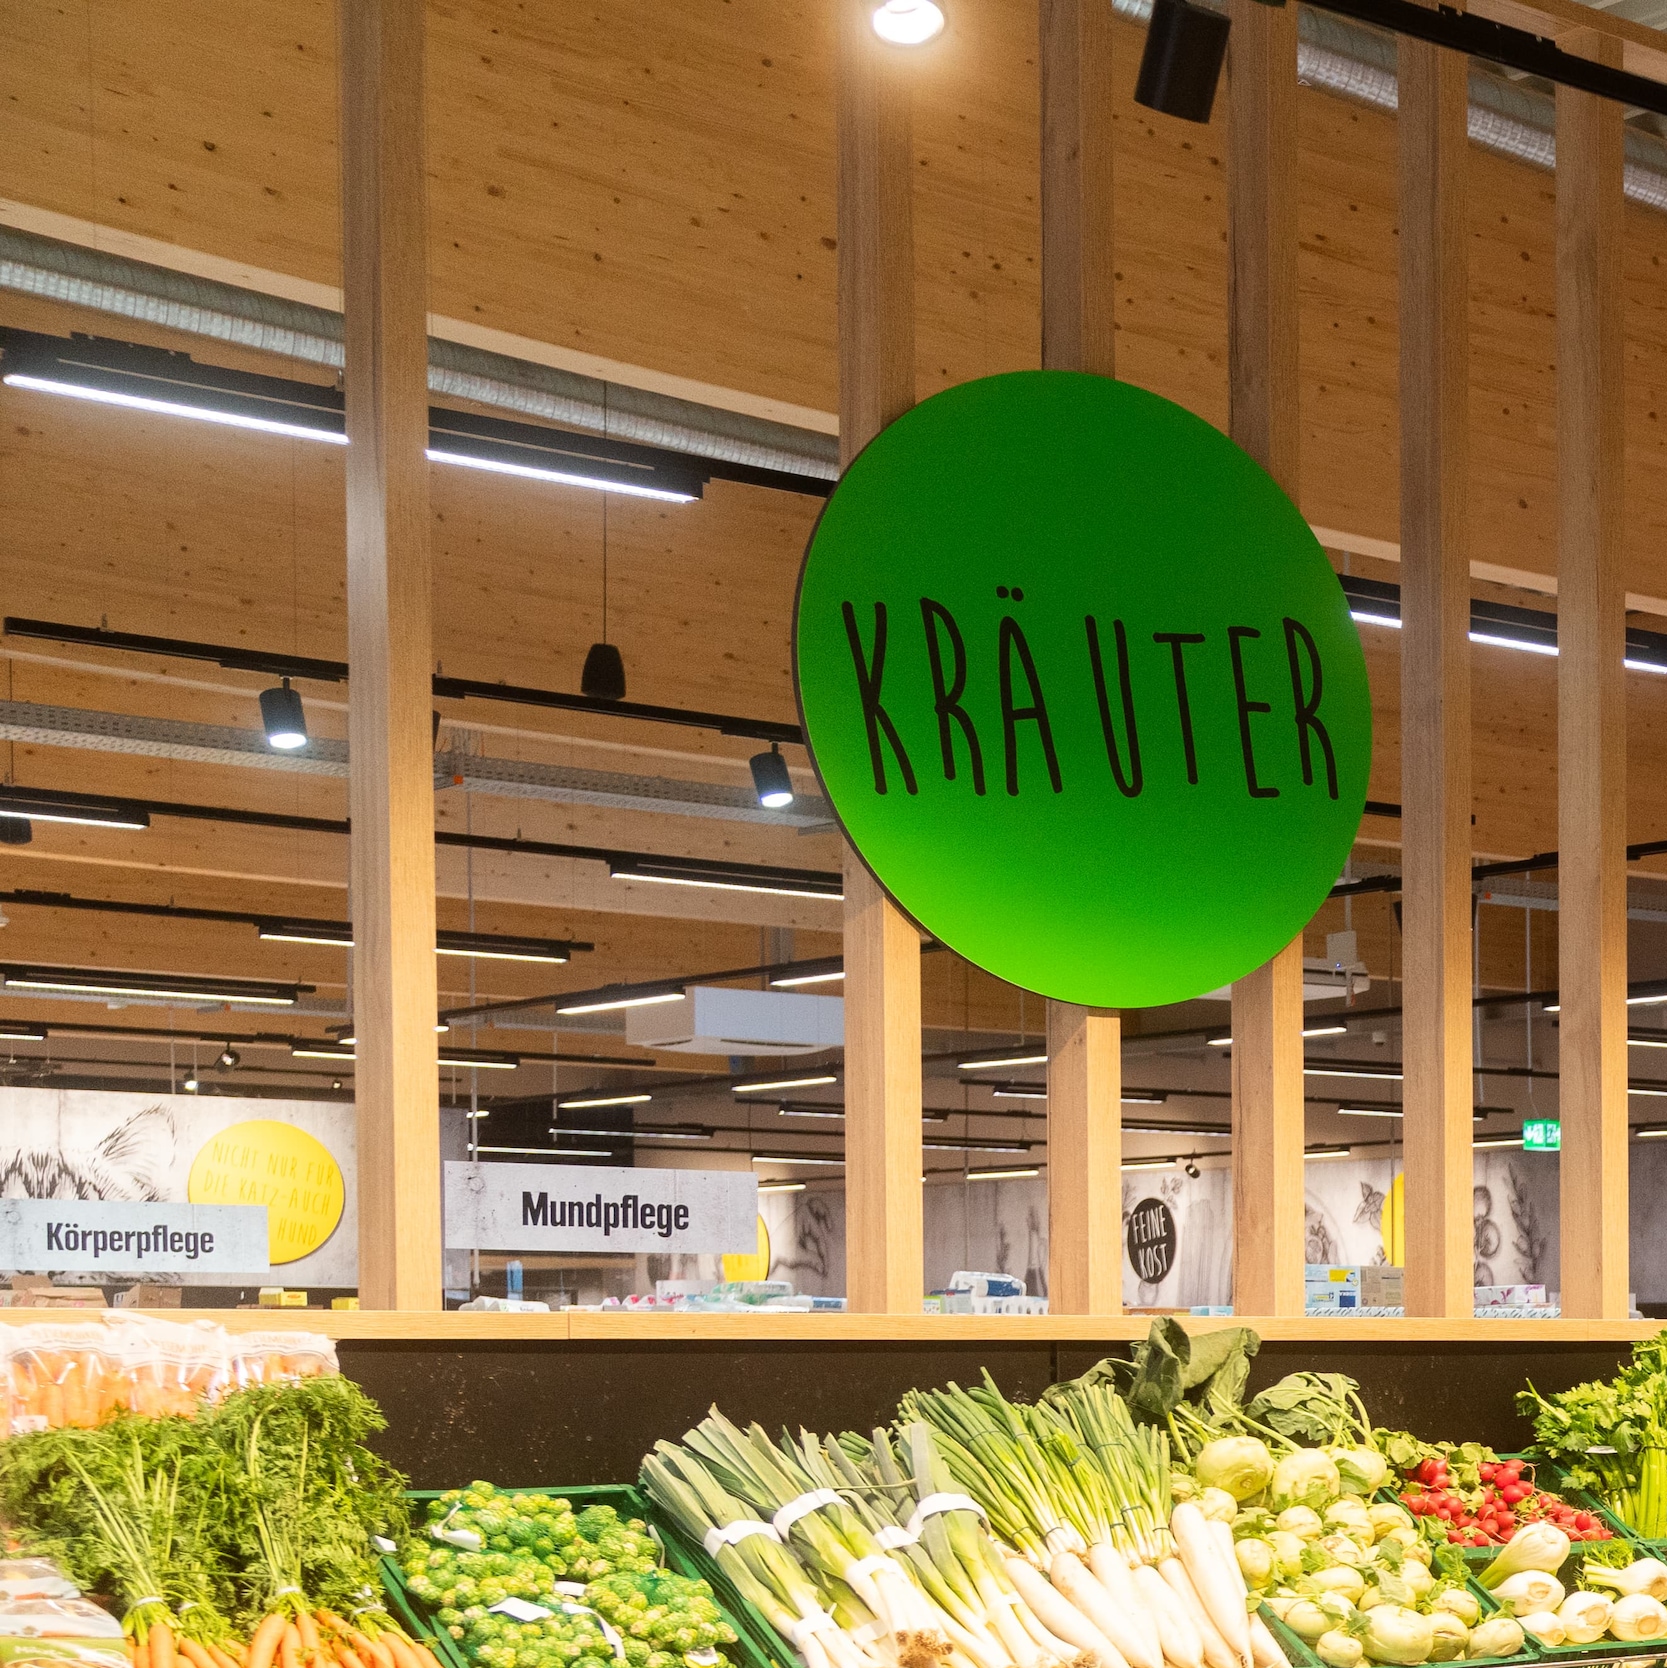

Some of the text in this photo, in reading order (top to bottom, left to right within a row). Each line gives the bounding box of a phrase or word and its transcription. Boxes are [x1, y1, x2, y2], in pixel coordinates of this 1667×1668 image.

[841, 585, 1339, 800] KRÄUTER
[212, 1142, 258, 1168] NICHT
[267, 1153, 298, 1179] NUR
[204, 1170, 229, 1197] DIE
[278, 1218, 317, 1246] HUND
[521, 1191, 690, 1237] Mundpflege
[1132, 1205, 1167, 1245] FEINE
[46, 1222, 215, 1259] Körperpflege
[1138, 1243, 1167, 1279] KOST
